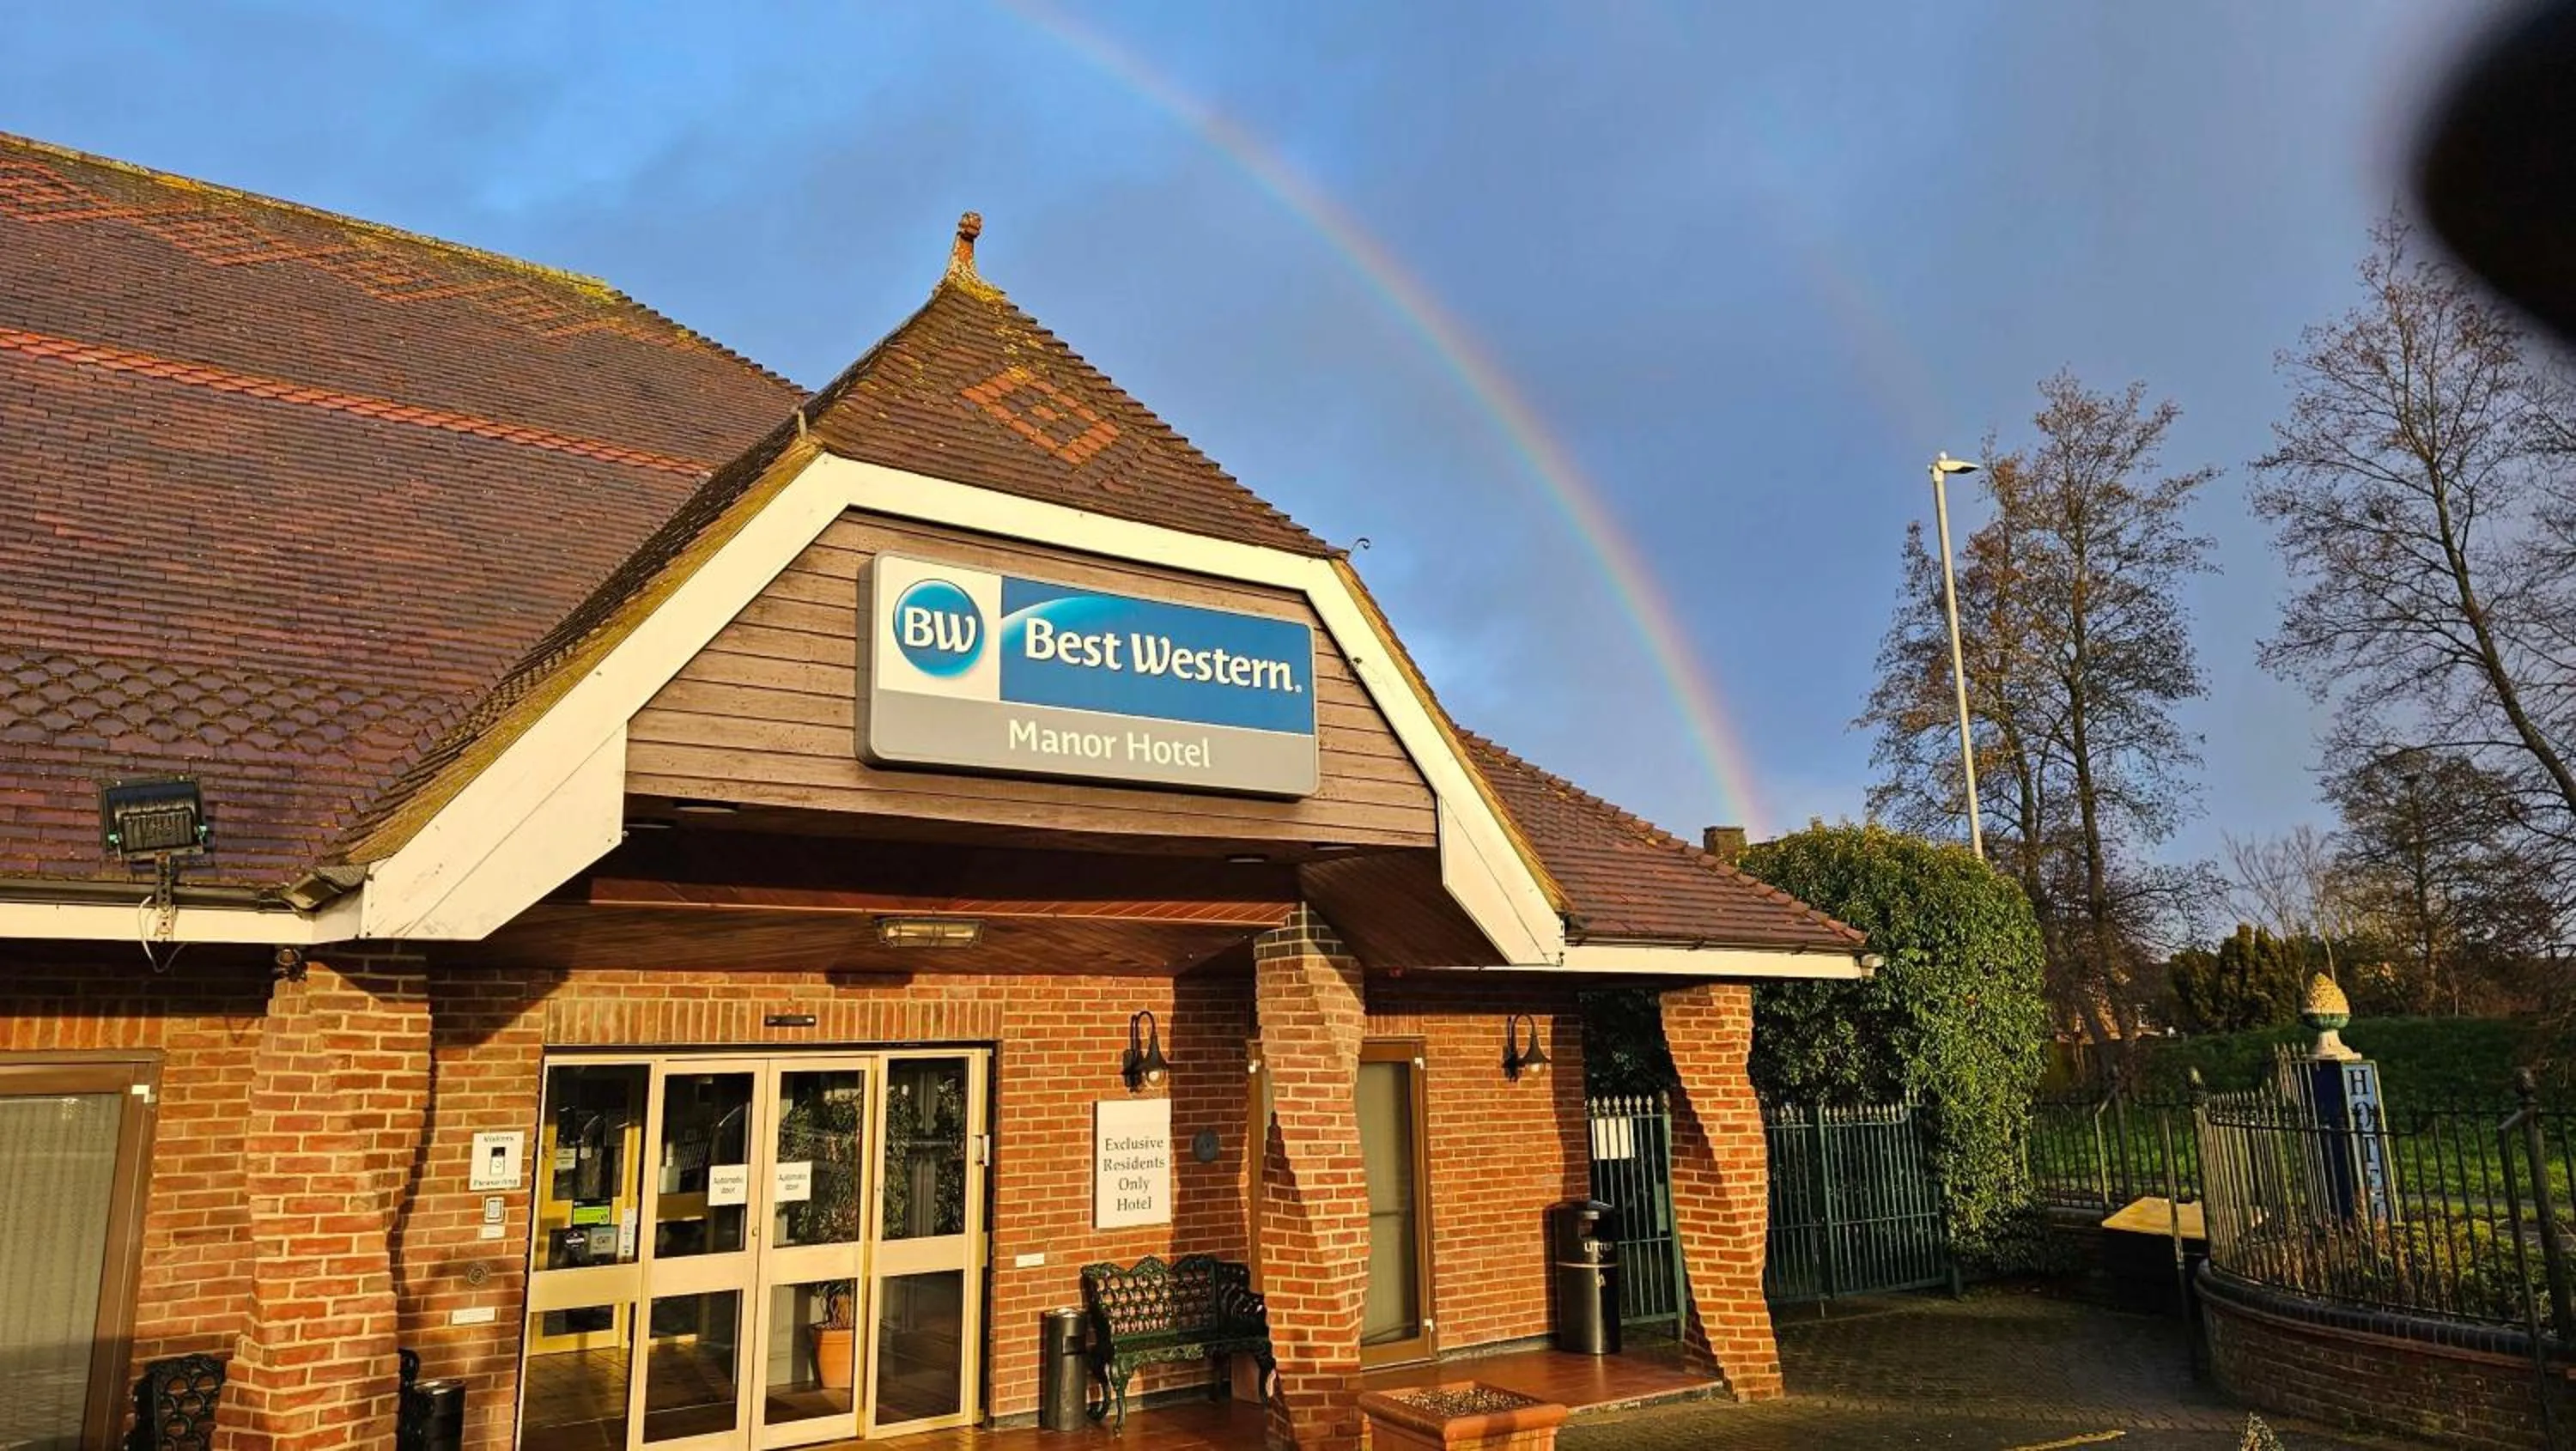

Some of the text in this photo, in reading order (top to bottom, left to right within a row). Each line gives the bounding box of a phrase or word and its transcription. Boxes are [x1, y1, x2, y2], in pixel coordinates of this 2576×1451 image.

[904, 606, 976, 653] BW
[1025, 617, 1123, 671] Best
[1008, 719, 1212, 768] Manor Hotel
[1104, 1136, 1164, 1151] Exclusive
[1103, 1155, 1165, 1172] Residents
[1118, 1175, 1151, 1193] Only
[1116, 1195, 1152, 1211] Hotel
